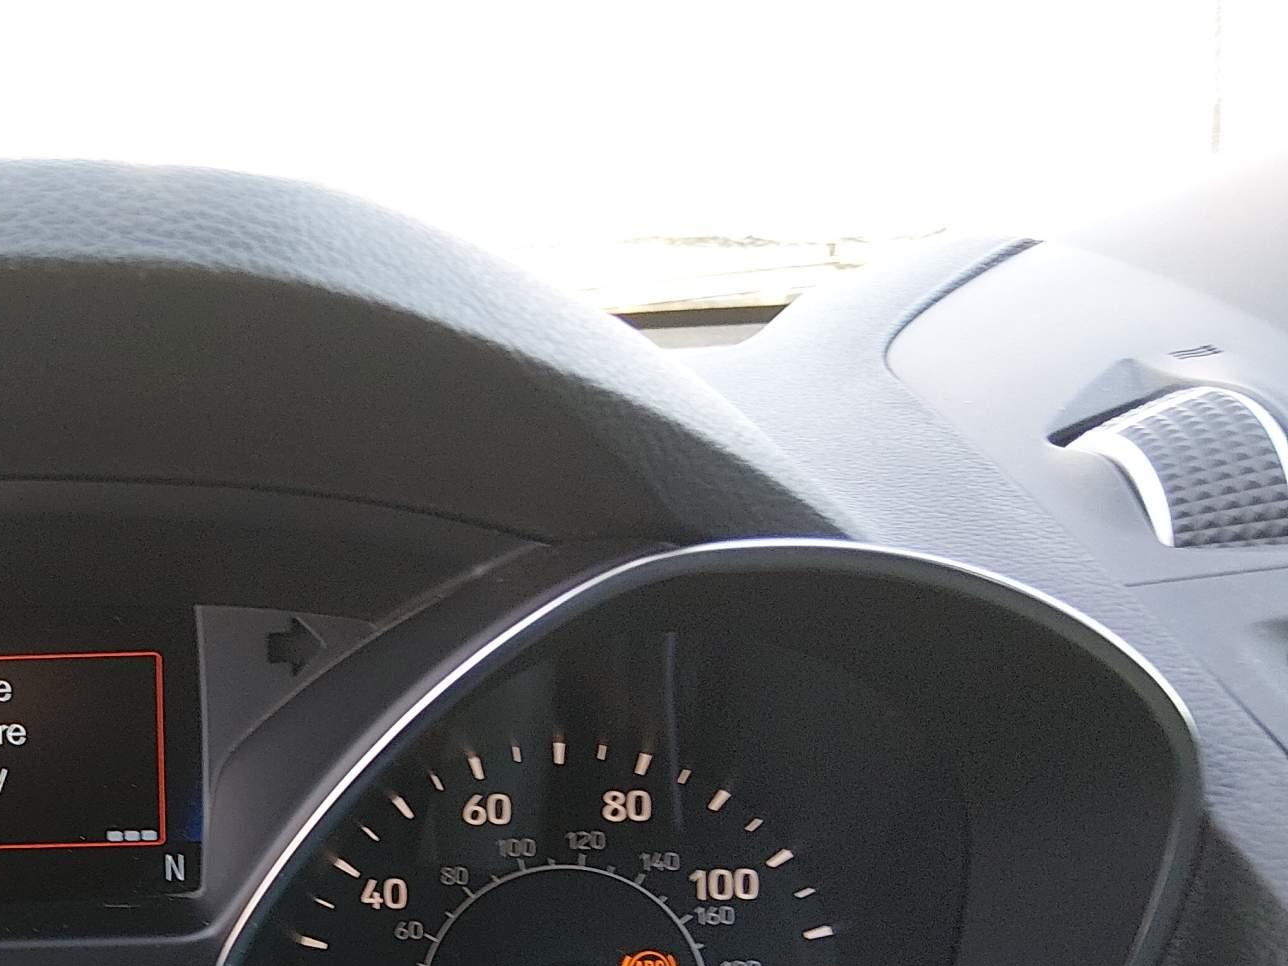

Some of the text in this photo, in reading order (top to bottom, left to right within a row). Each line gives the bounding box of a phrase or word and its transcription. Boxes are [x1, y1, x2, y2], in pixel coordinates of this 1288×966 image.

[463, 793, 511, 826] 60
[602, 790, 652, 822] 80
[497, 838, 537, 858] 100
[566, 830, 606, 850] 120
[165, 854, 185, 881] N
[641, 852, 681, 872] 140
[441, 866, 469, 885] 80
[689, 868, 759, 901] 100
[360, 878, 408, 910] 40
[694, 905, 735, 925] 160
[395, 921, 424, 940] 60
